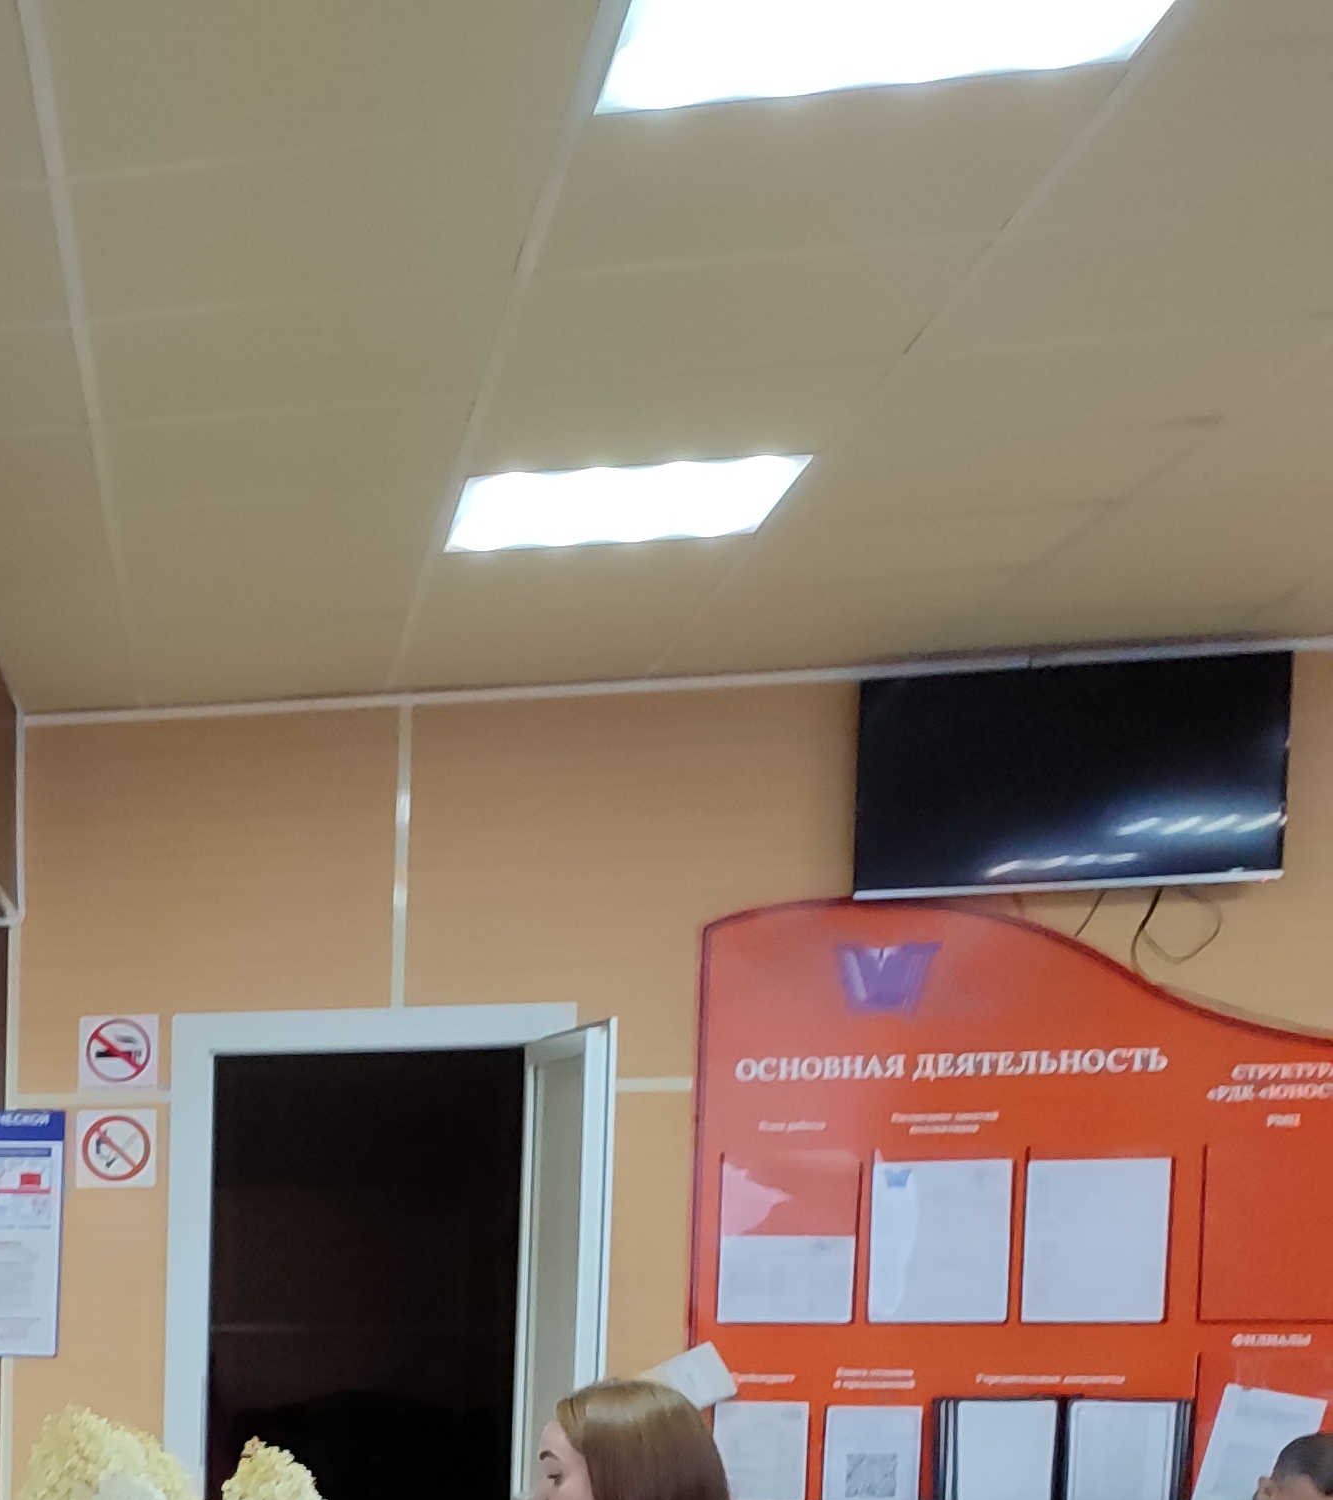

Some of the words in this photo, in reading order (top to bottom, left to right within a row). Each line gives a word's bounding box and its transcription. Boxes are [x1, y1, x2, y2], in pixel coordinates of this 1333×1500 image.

[735, 1053, 907, 1083] ОСНОВНАЯ
[911, 1047, 1169, 1083] ДЕЯТЕЛЬНОСТЬ
[1231, 1061, 1333, 1082] СТРУКТУР
